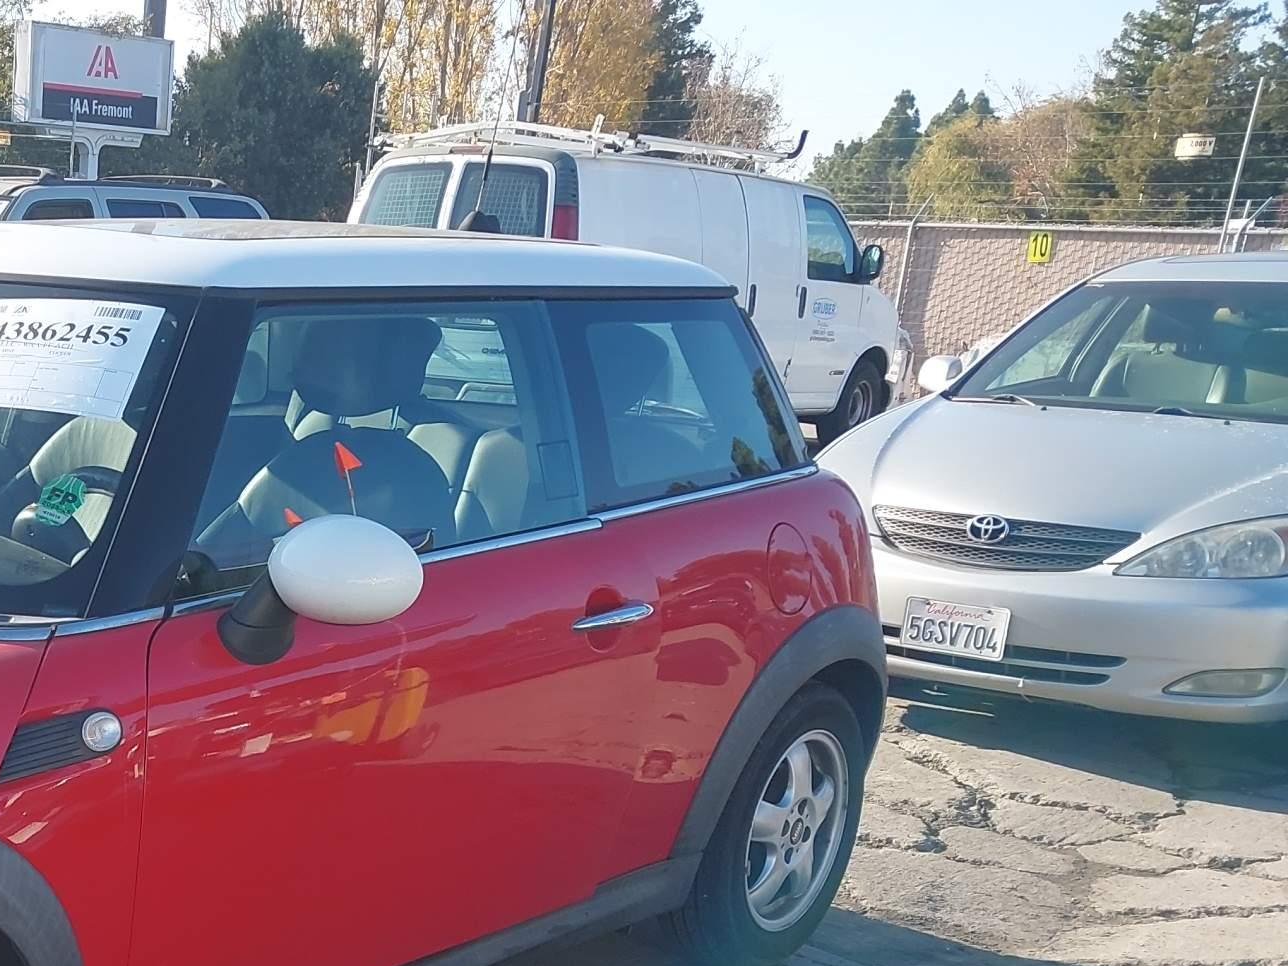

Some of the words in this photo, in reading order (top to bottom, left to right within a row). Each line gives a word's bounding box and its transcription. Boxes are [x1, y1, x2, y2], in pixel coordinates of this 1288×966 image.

[70, 97, 90, 115] IAA
[92, 99, 133, 119] Fremont
[1032, 233, 1049, 258] 10
[927, 602, 991, 621] California
[908, 616, 998, 653] 5GSV704
